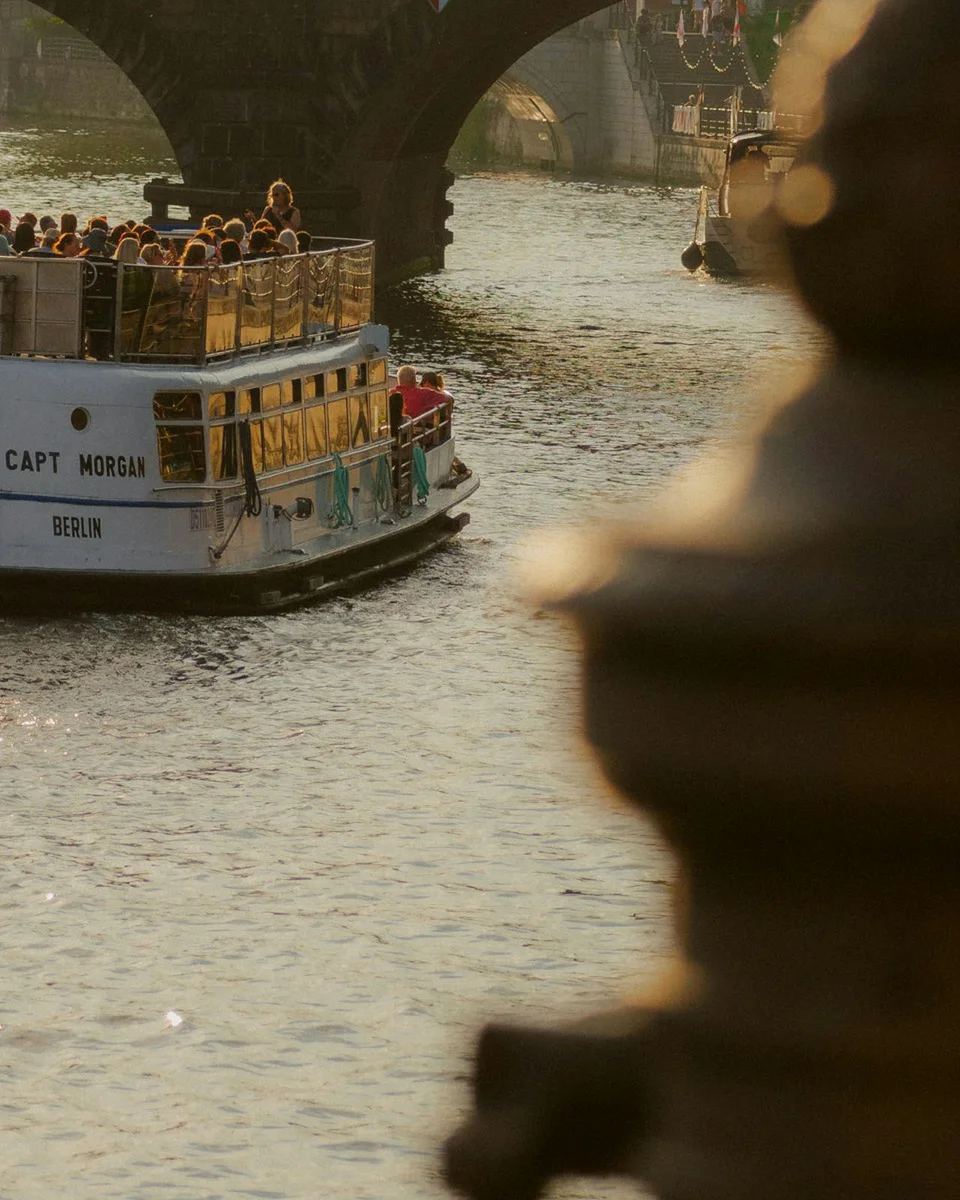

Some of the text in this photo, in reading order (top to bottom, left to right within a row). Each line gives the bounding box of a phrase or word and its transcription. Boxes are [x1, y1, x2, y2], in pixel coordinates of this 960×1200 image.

[5, 449, 146, 478] CAPT MORGAN
[52, 515, 102, 539] BERLIN
